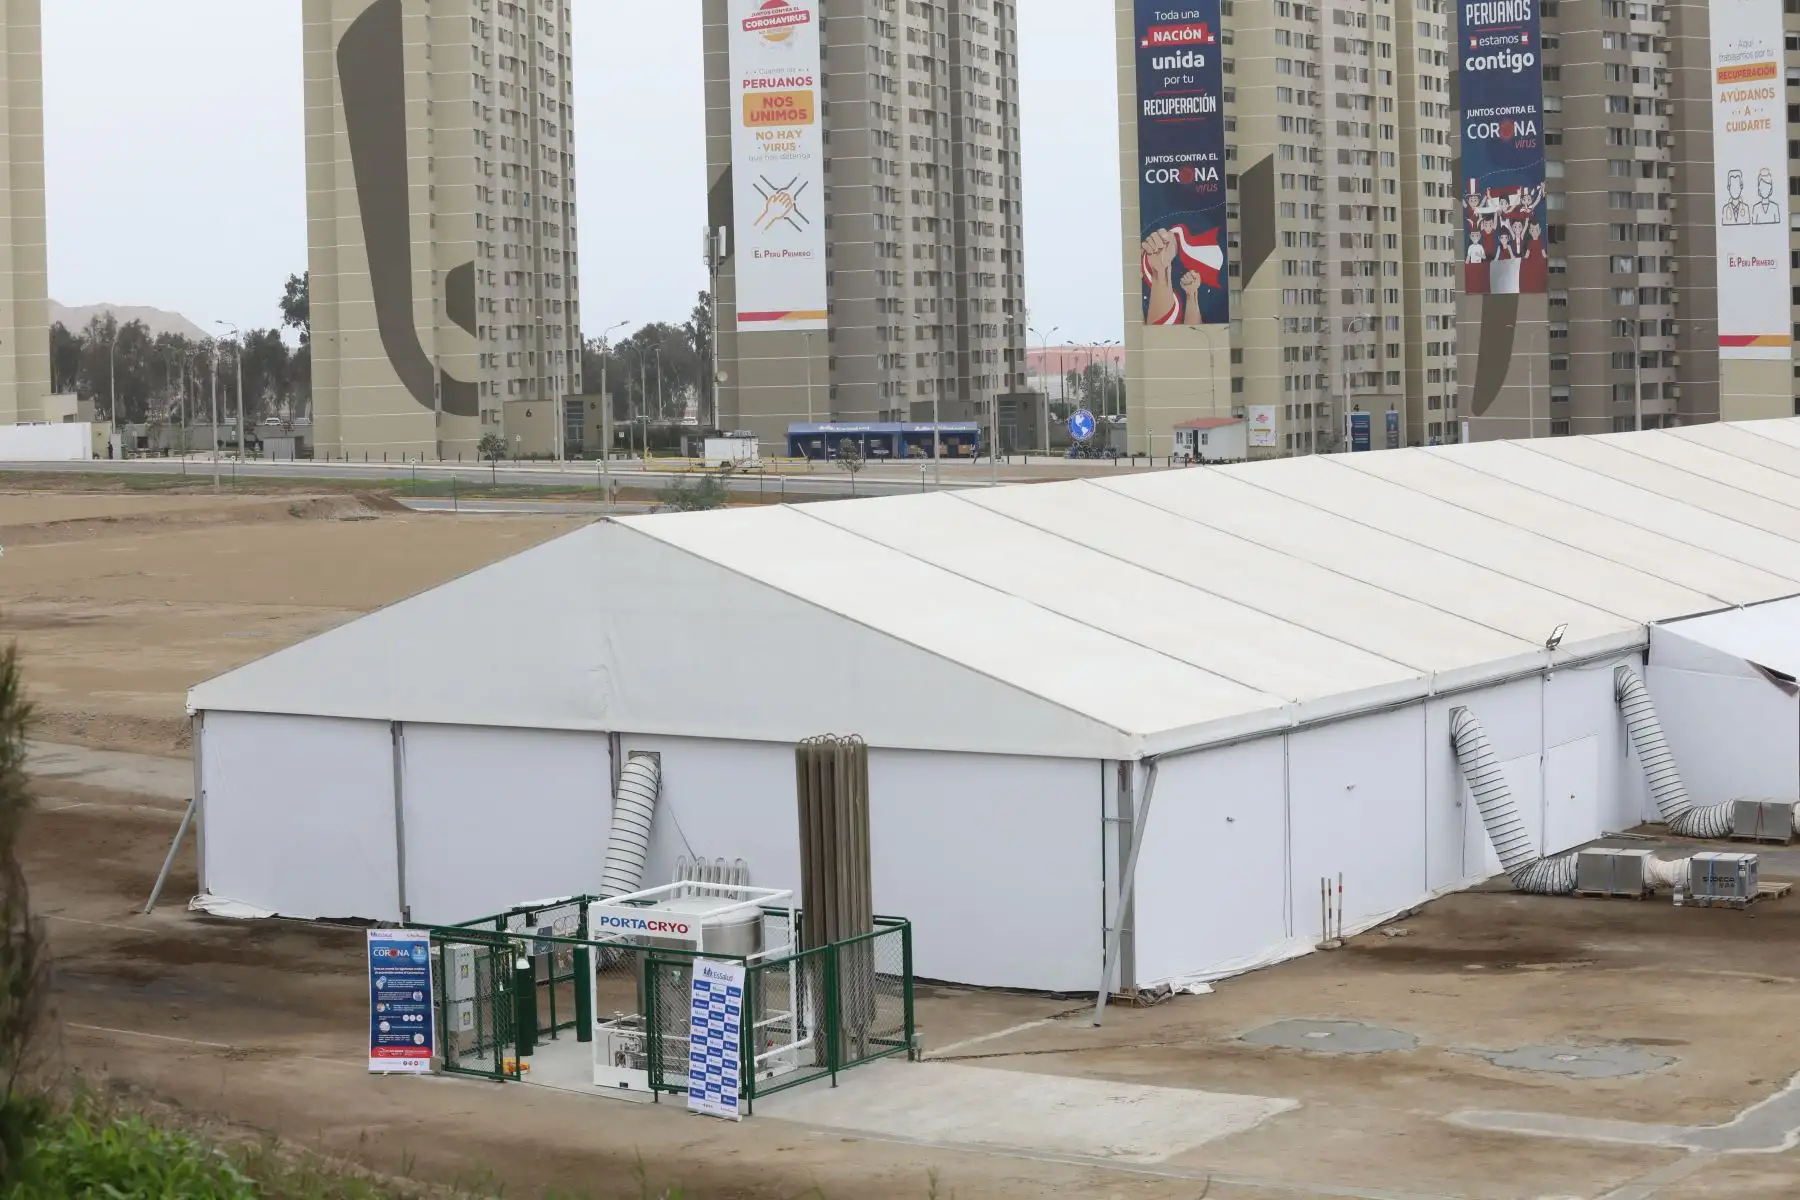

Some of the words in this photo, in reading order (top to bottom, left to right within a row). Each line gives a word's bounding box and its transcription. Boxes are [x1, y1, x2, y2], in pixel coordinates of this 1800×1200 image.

[1155, 10, 1179, 21] Toda
[1181, 10, 1200, 19] una
[1466, 0, 1531, 26] PERUANOS
[745, 13, 808, 29] CORONAVIRUS
[1153, 26, 1202, 42] NACIÓN
[1480, 34, 1519, 46] estamos
[1152, 50, 1205, 70] unida
[1465, 48, 1535, 74] contigo
[743, 76, 813, 89] PERUANOS
[1164, 76, 1180, 87] por
[1182, 74, 1194, 83] tu
[763, 96, 794, 109] NOS
[1144, 94, 1216, 116] RECUPERACIÓN
[750, 109, 808, 122] UNIMOS
[1467, 108, 1495, 119] JUNTOS
[1495, 106, 1526, 116] CONTRA
[1528, 105, 1536, 113] EL
[1744, 105, 1751, 116] A
[1726, 118, 1771, 132] CUIDARTE
[756, 131, 774, 141] NO
[777, 129, 803, 139] HAY
[763, 142, 797, 152] VIRUS
[1145, 155, 1174, 165] JUNTOS
[1175, 153, 1207, 163] CONTRA
[1208, 152, 1218, 161] EL
[525, 408, 532, 418] 6
[1353, 403, 1359, 412] 4
[600, 916, 688, 934] PORTACRYO
